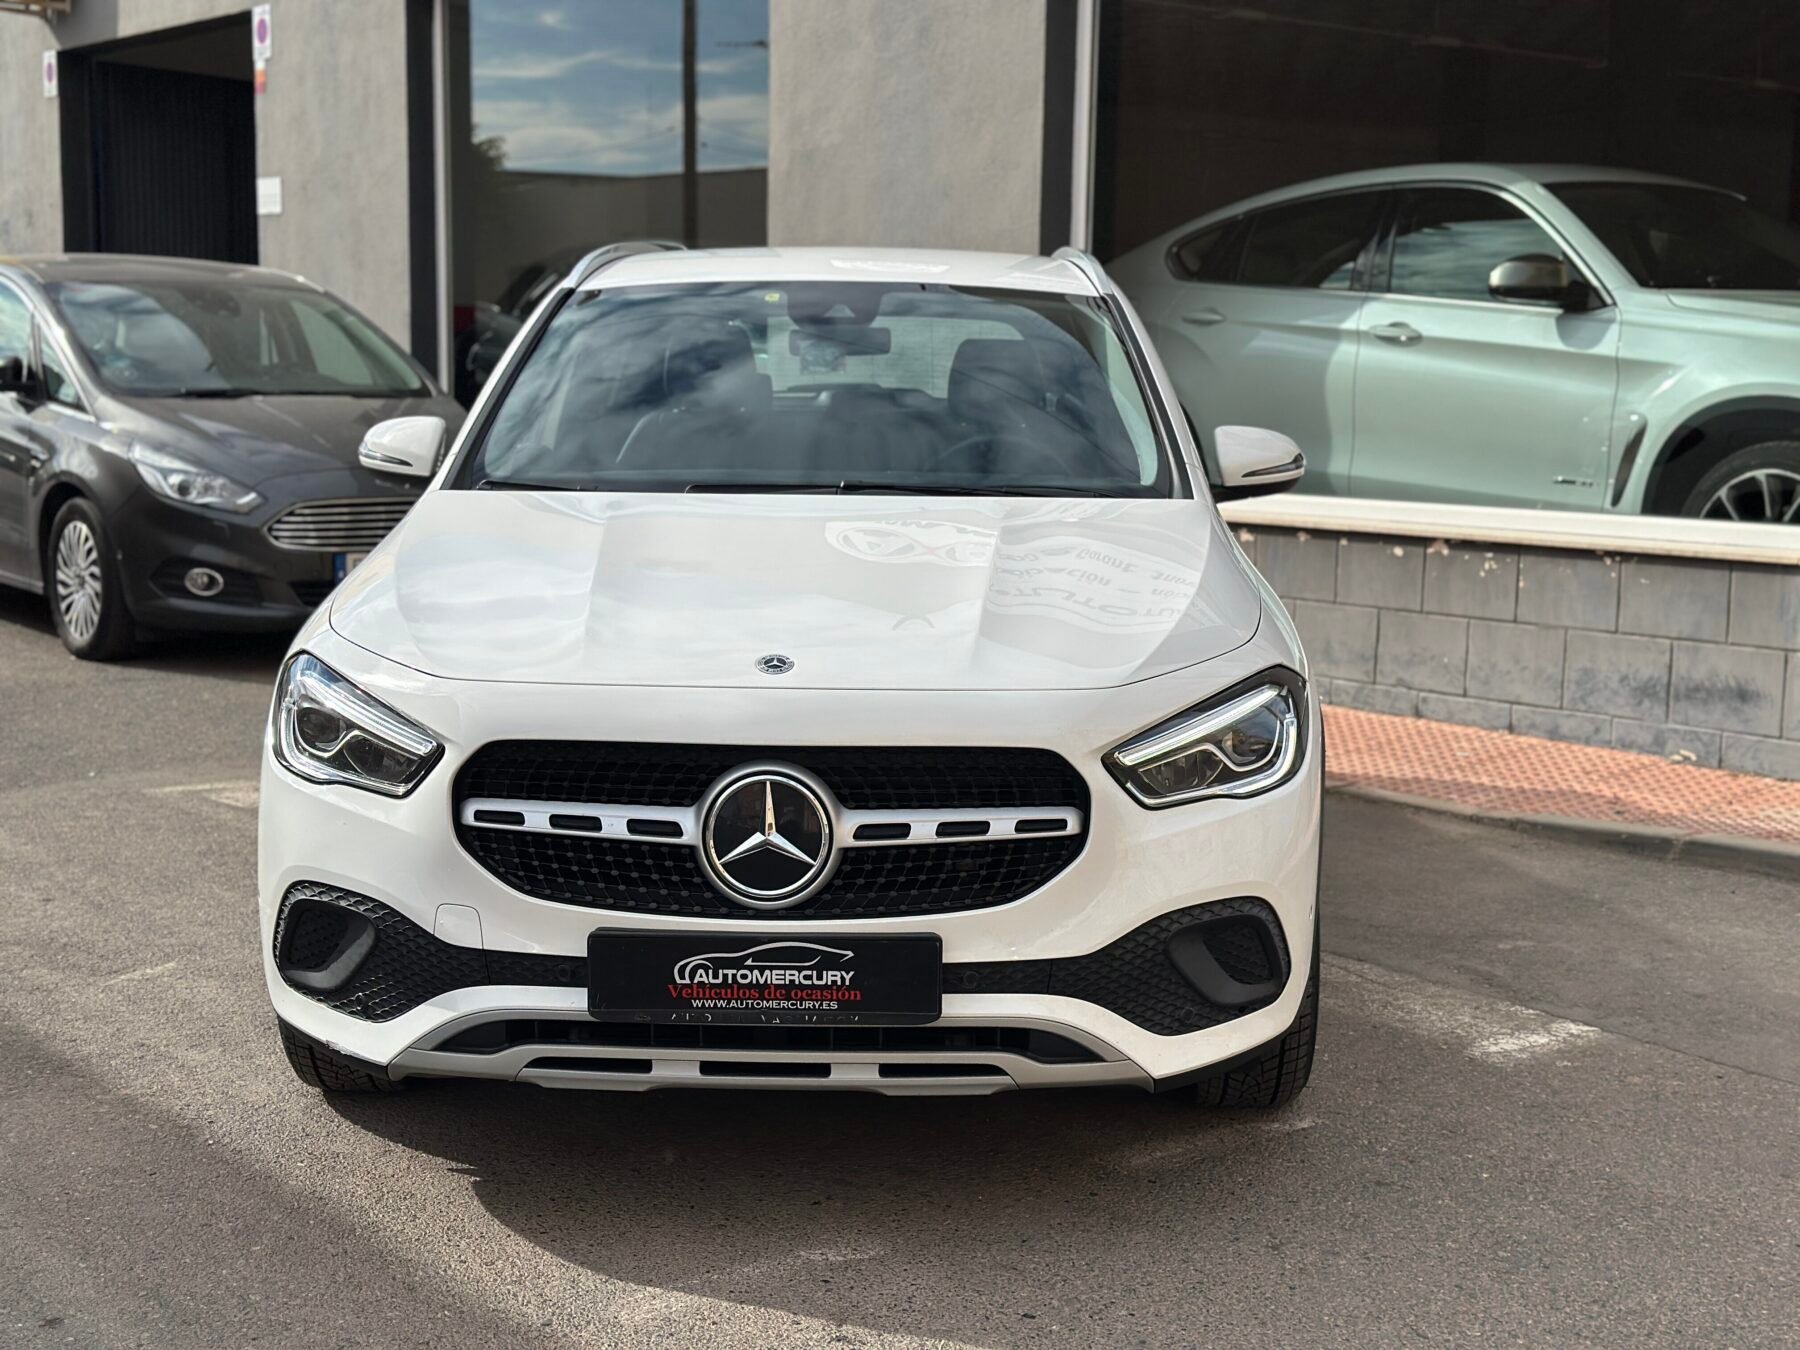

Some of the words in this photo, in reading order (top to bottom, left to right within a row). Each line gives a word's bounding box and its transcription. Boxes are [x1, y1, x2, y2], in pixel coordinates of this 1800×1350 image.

[693, 969, 855, 985] AUTOMERCURY
[668, 984, 759, 999] Vehículos
[764, 985, 786, 1000] de
[790, 985, 862, 1001] ocasión
[692, 1000, 838, 1009] WWW.AUTOMERCURY.ES
